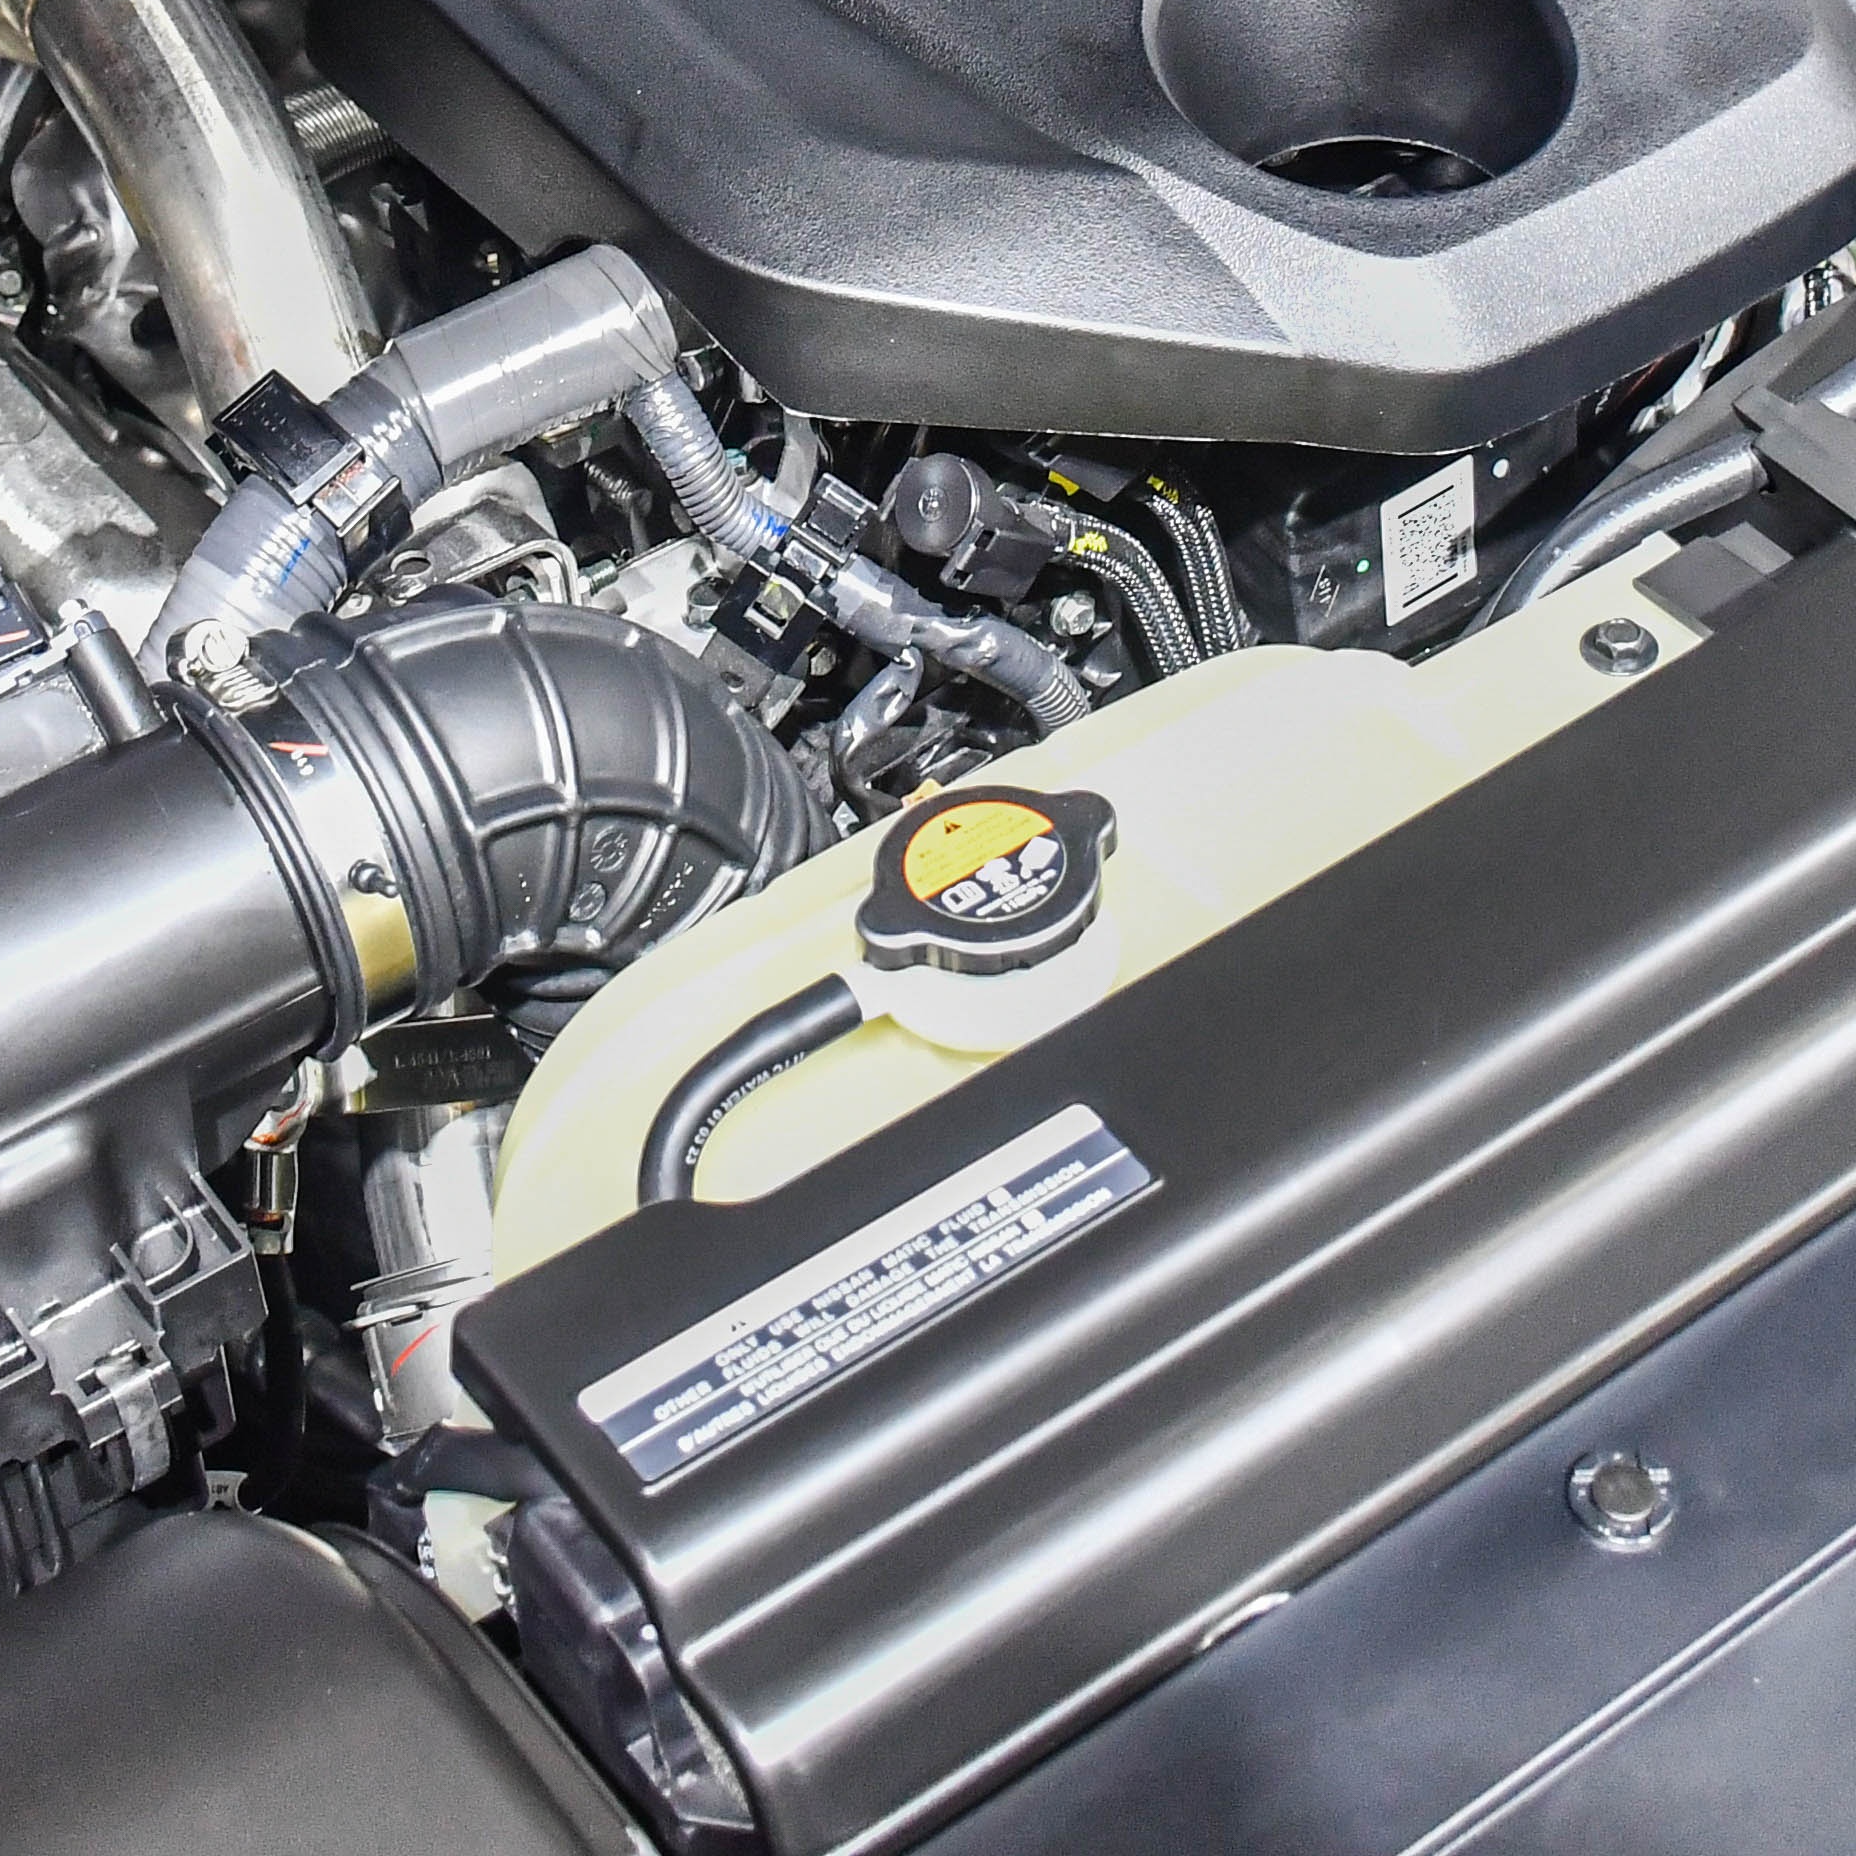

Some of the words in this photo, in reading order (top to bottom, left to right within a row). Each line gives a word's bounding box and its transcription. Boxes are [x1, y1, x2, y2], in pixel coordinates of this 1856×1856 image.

[720, 1069, 771, 1112] WATER
[707, 1109, 723, 1127] 01
[694, 1125, 710, 1145] 03
[685, 1146, 700, 1166] 23
[979, 1253, 1002, 1273] LA
[653, 1381, 711, 1421] OTHER
[722, 1340, 781, 1380] FLUIDS
[792, 1311, 834, 1337] WILL
[845, 1262, 914, 1308] DAMAGE
[924, 1235, 958, 1259] THE
[967, 1160, 1085, 1233] TRANSMISSION
[715, 1335, 757, 1366] ONLY
[768, 1310, 803, 1335] USE
[812, 1269, 873, 1309] NISSAN
[881, 1234, 931, 1268] MATIC
[939, 1203, 985, 1234] FLUID
